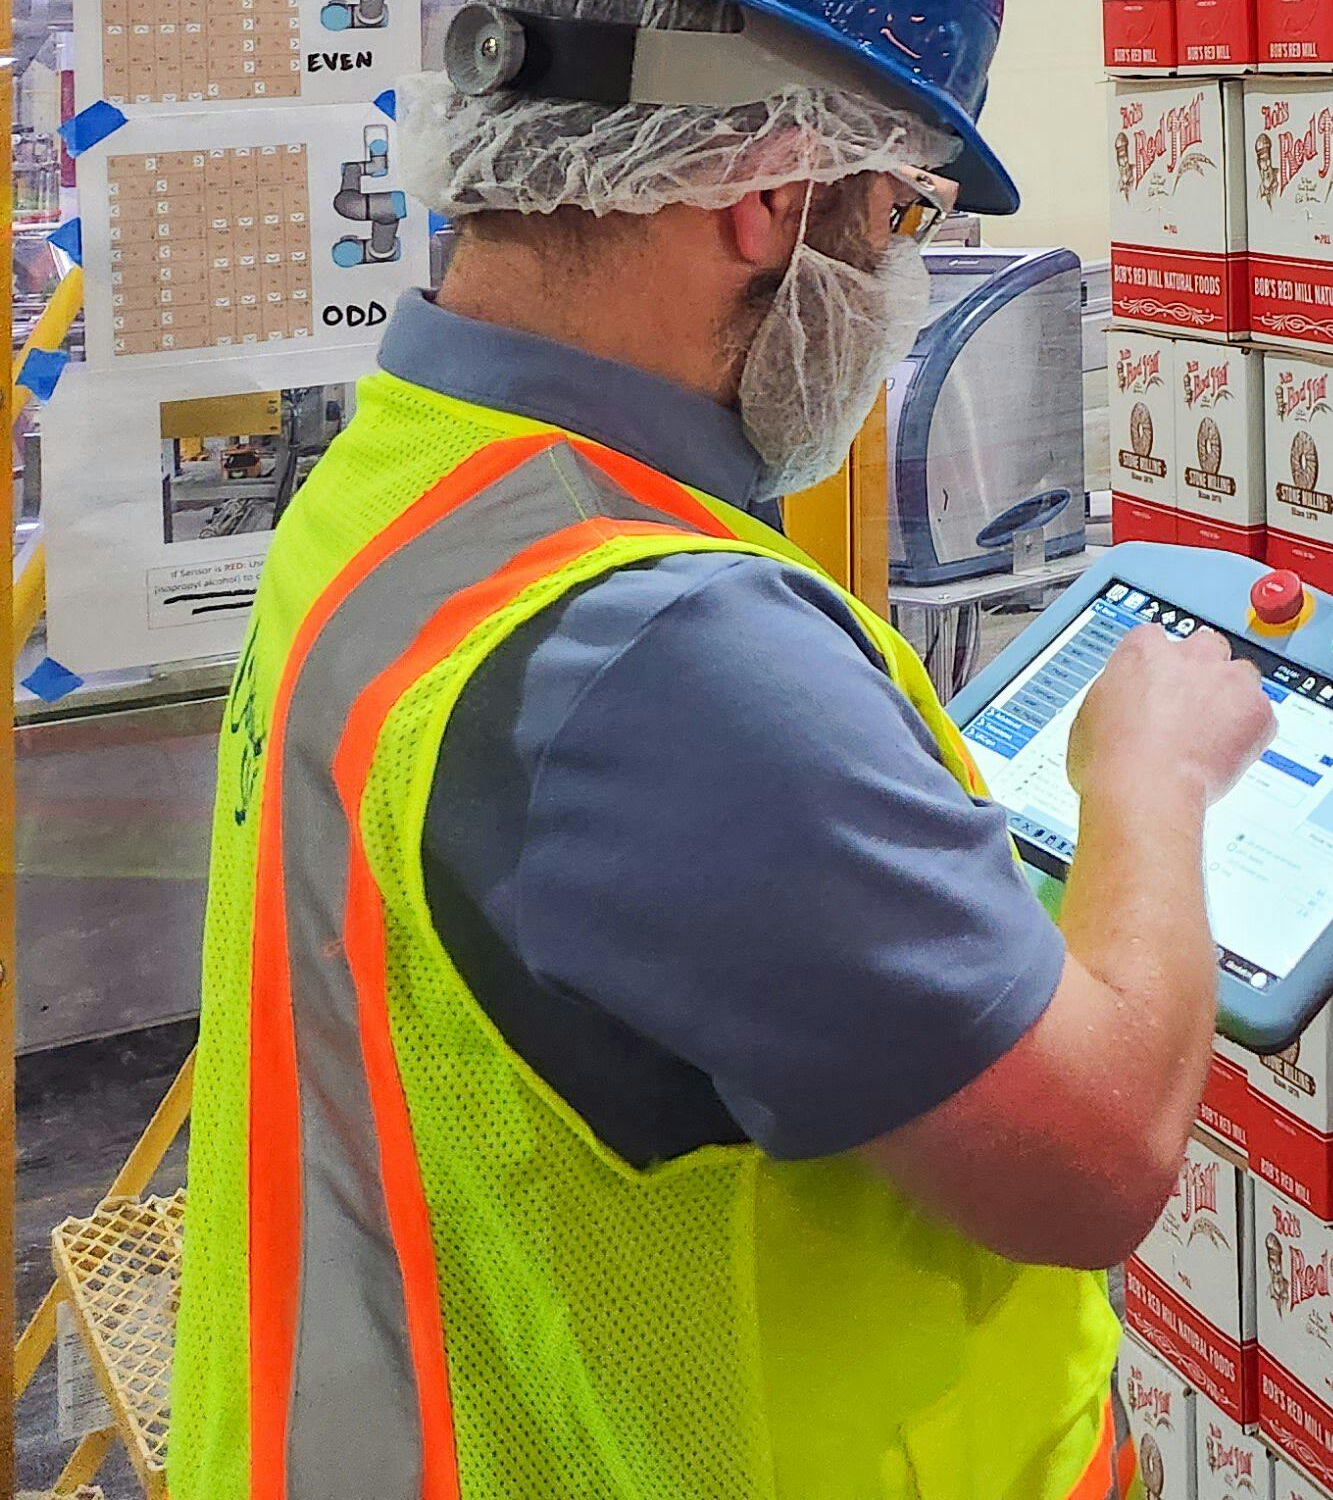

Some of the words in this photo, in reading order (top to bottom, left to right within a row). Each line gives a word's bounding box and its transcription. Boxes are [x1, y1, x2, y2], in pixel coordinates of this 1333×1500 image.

[307, 50, 373, 74] EVEN
[1262, 102, 1289, 130] Bob's
[1279, 113, 1318, 197] Red
[1254, 277, 1276, 298] BOB'S
[1277, 280, 1293, 300] RED
[1295, 283, 1313, 303] MILL
[322, 302, 388, 328] ODD
[1289, 1246, 1329, 1312] Red
